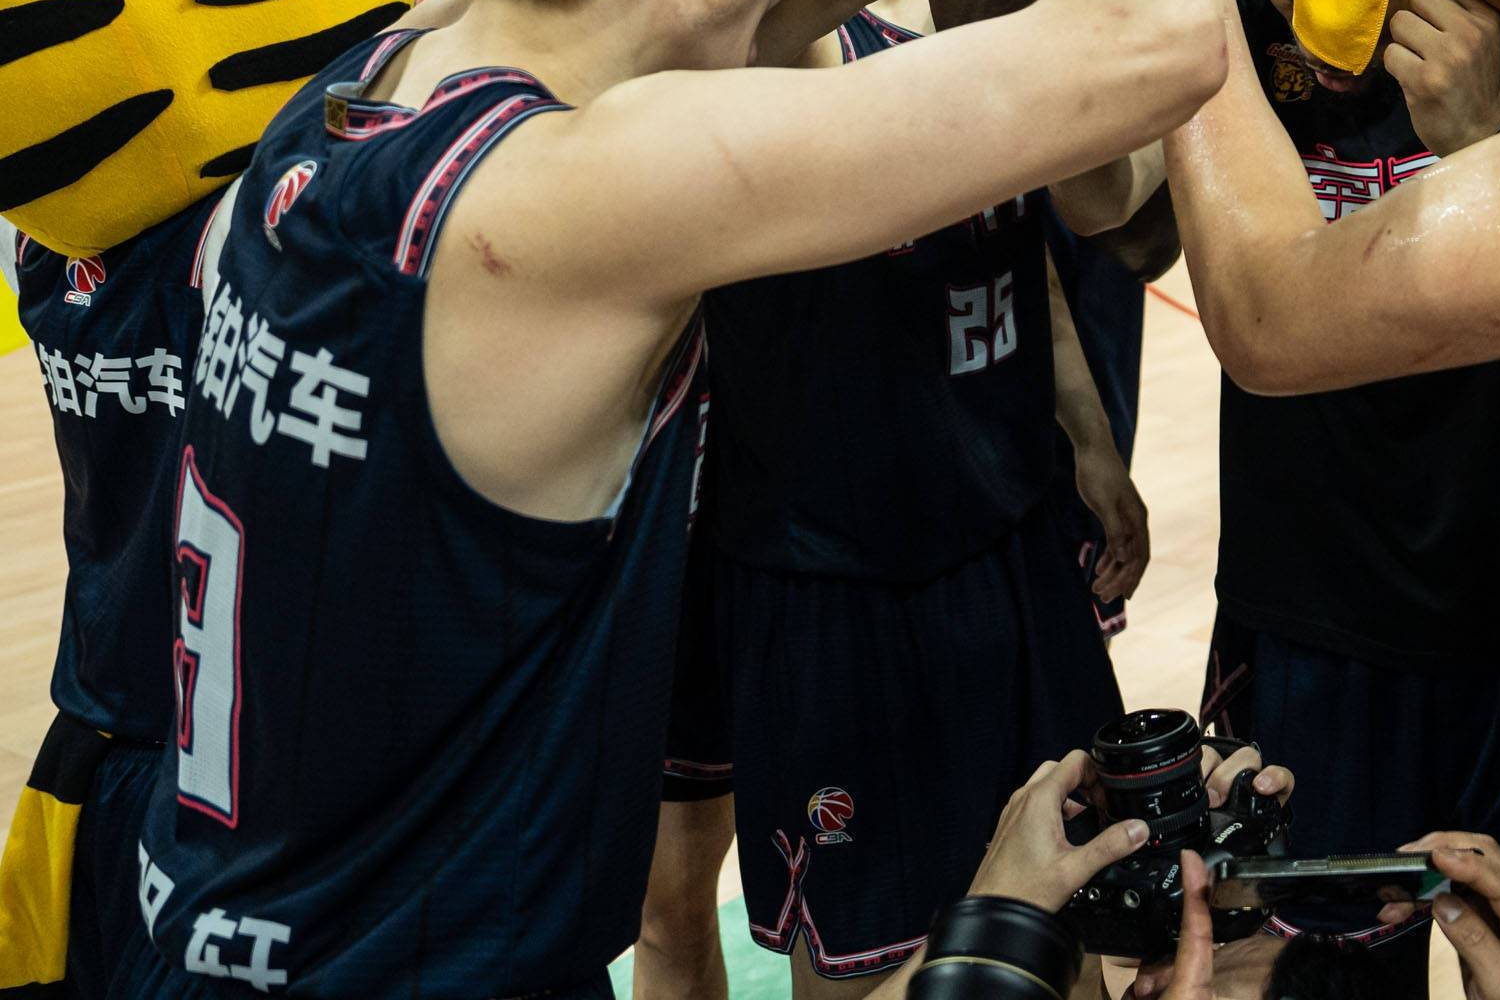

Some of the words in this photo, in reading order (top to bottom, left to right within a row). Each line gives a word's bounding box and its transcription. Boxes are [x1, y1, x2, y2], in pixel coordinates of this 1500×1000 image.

[193, 281, 371, 468] 铂汽车
[1214, 822, 1243, 844] Canon
